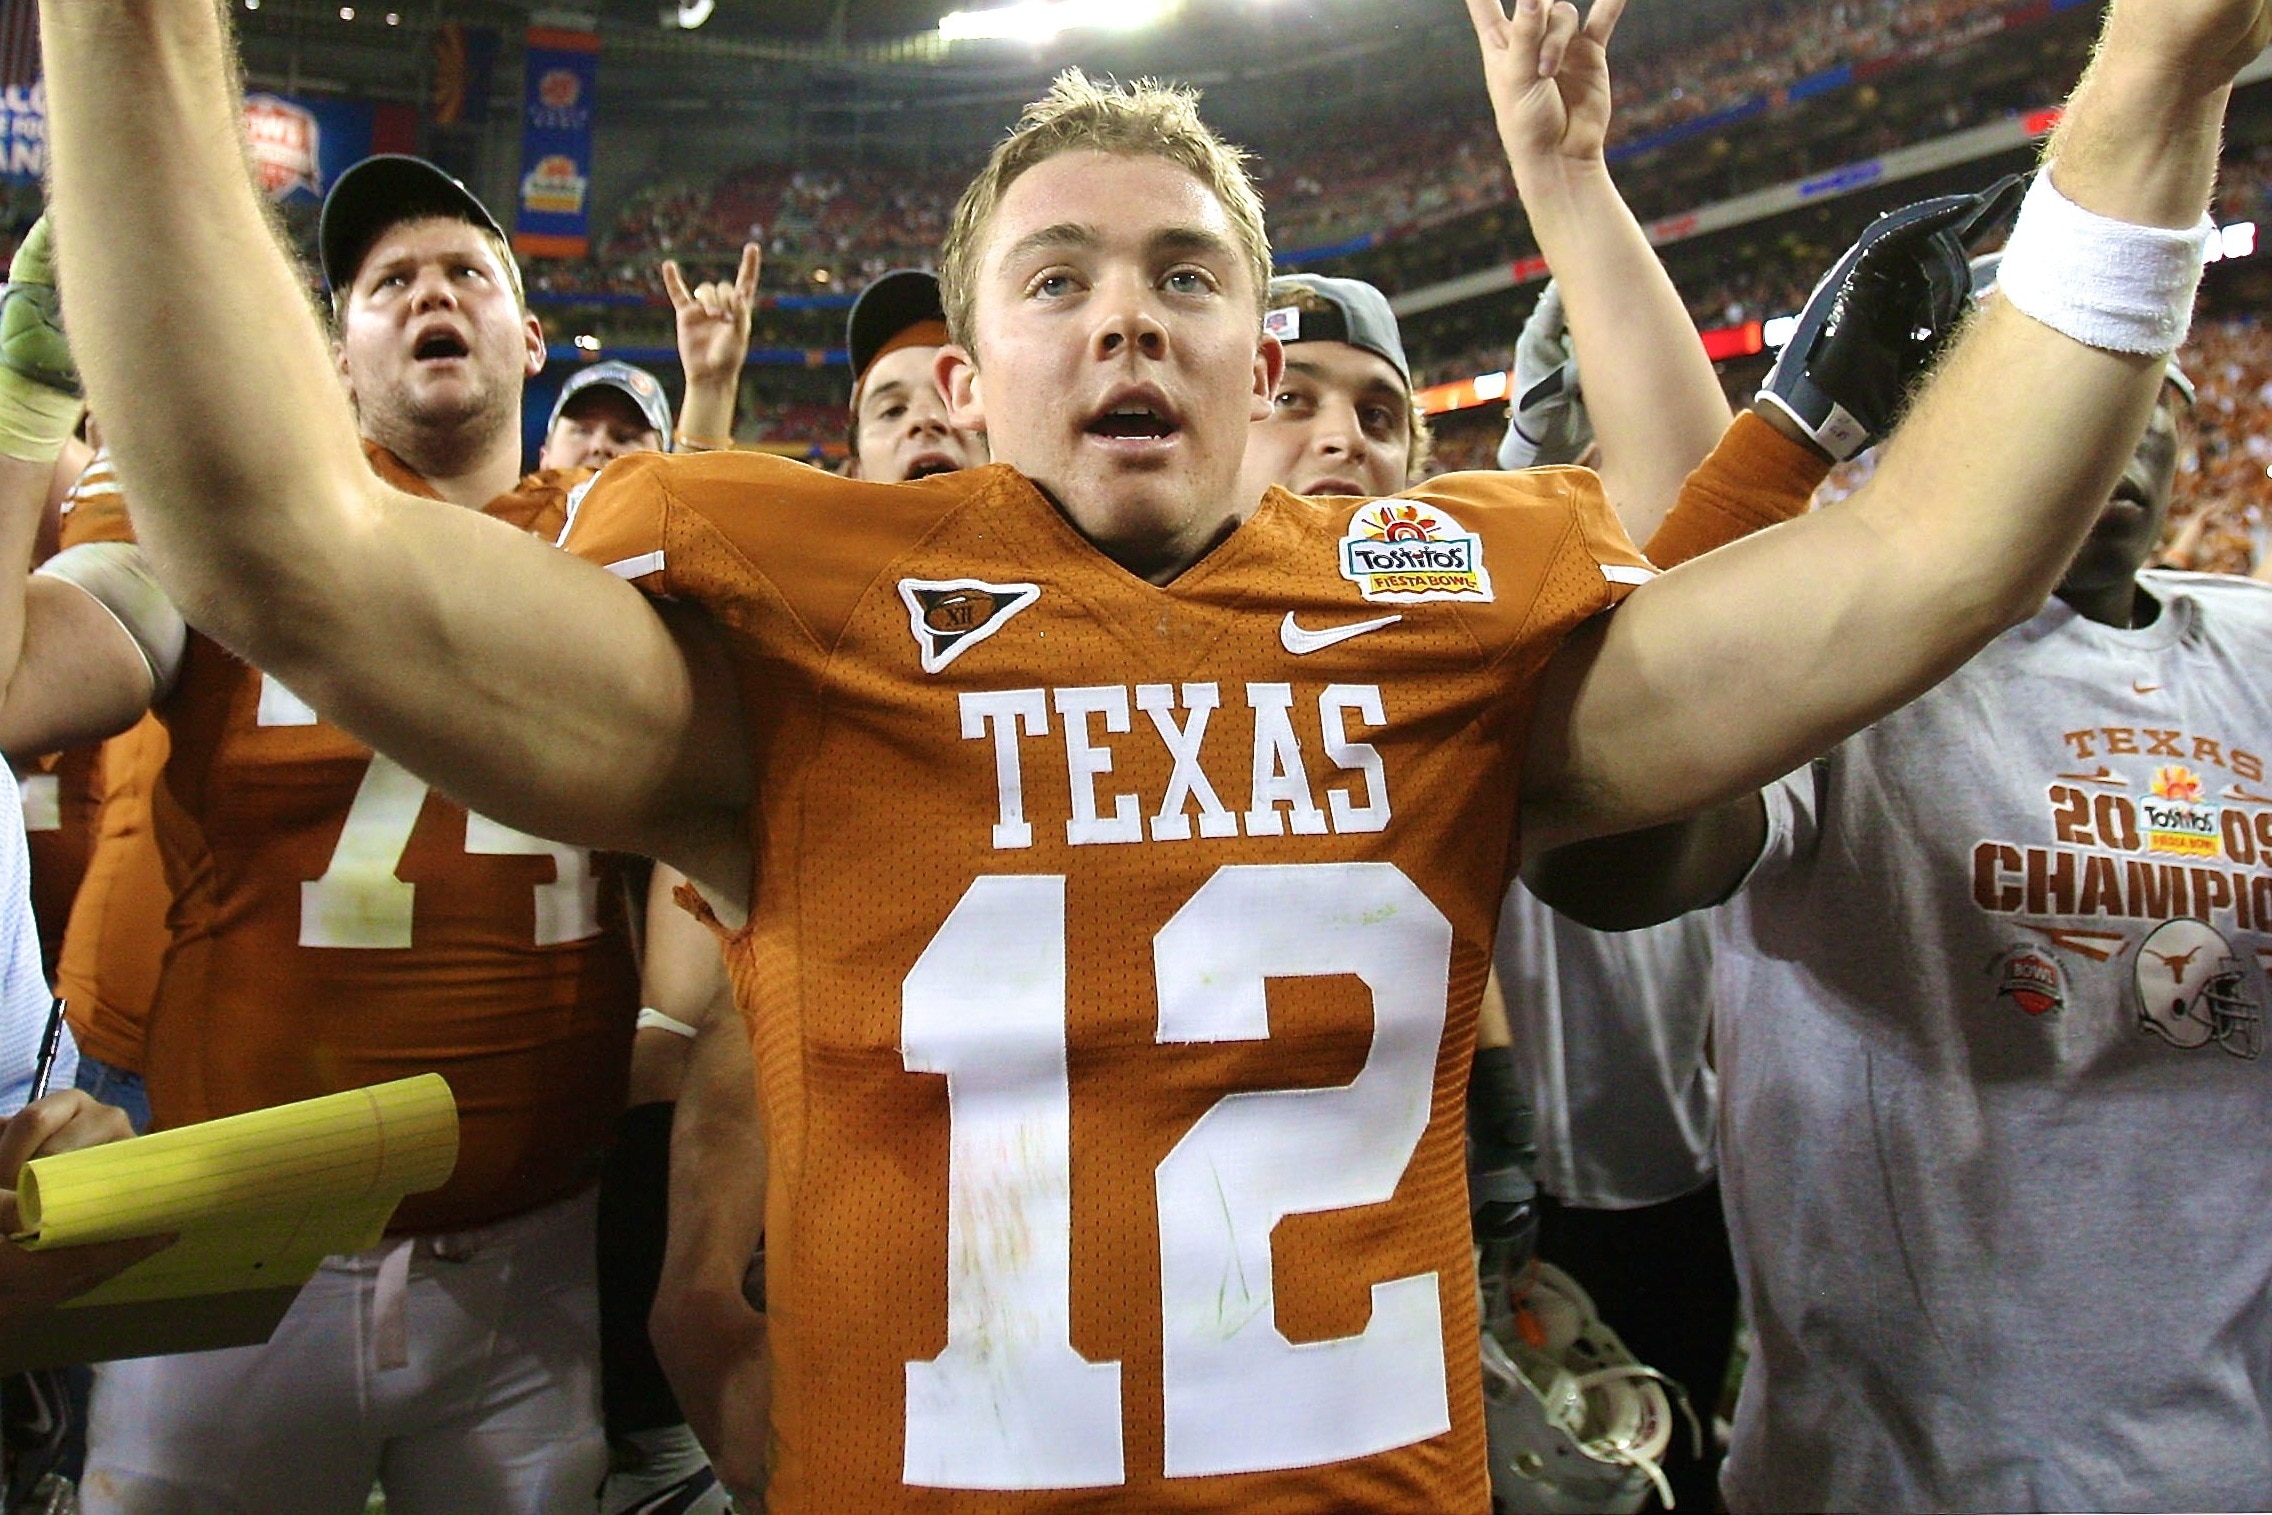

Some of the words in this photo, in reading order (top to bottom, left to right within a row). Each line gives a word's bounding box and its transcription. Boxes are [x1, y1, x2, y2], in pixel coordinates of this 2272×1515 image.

[1355, 546, 1465, 570] Tostitos
[1373, 575, 1426, 588] FIESTA
[1428, 575, 1478, 589] BOWL
[946, 606, 973, 626] XII
[958, 682, 1392, 849] TEXAS
[2064, 728, 2264, 782] TEXAS
[2048, 785, 2140, 850] 20
[901, 861, 1453, 1490] 12
